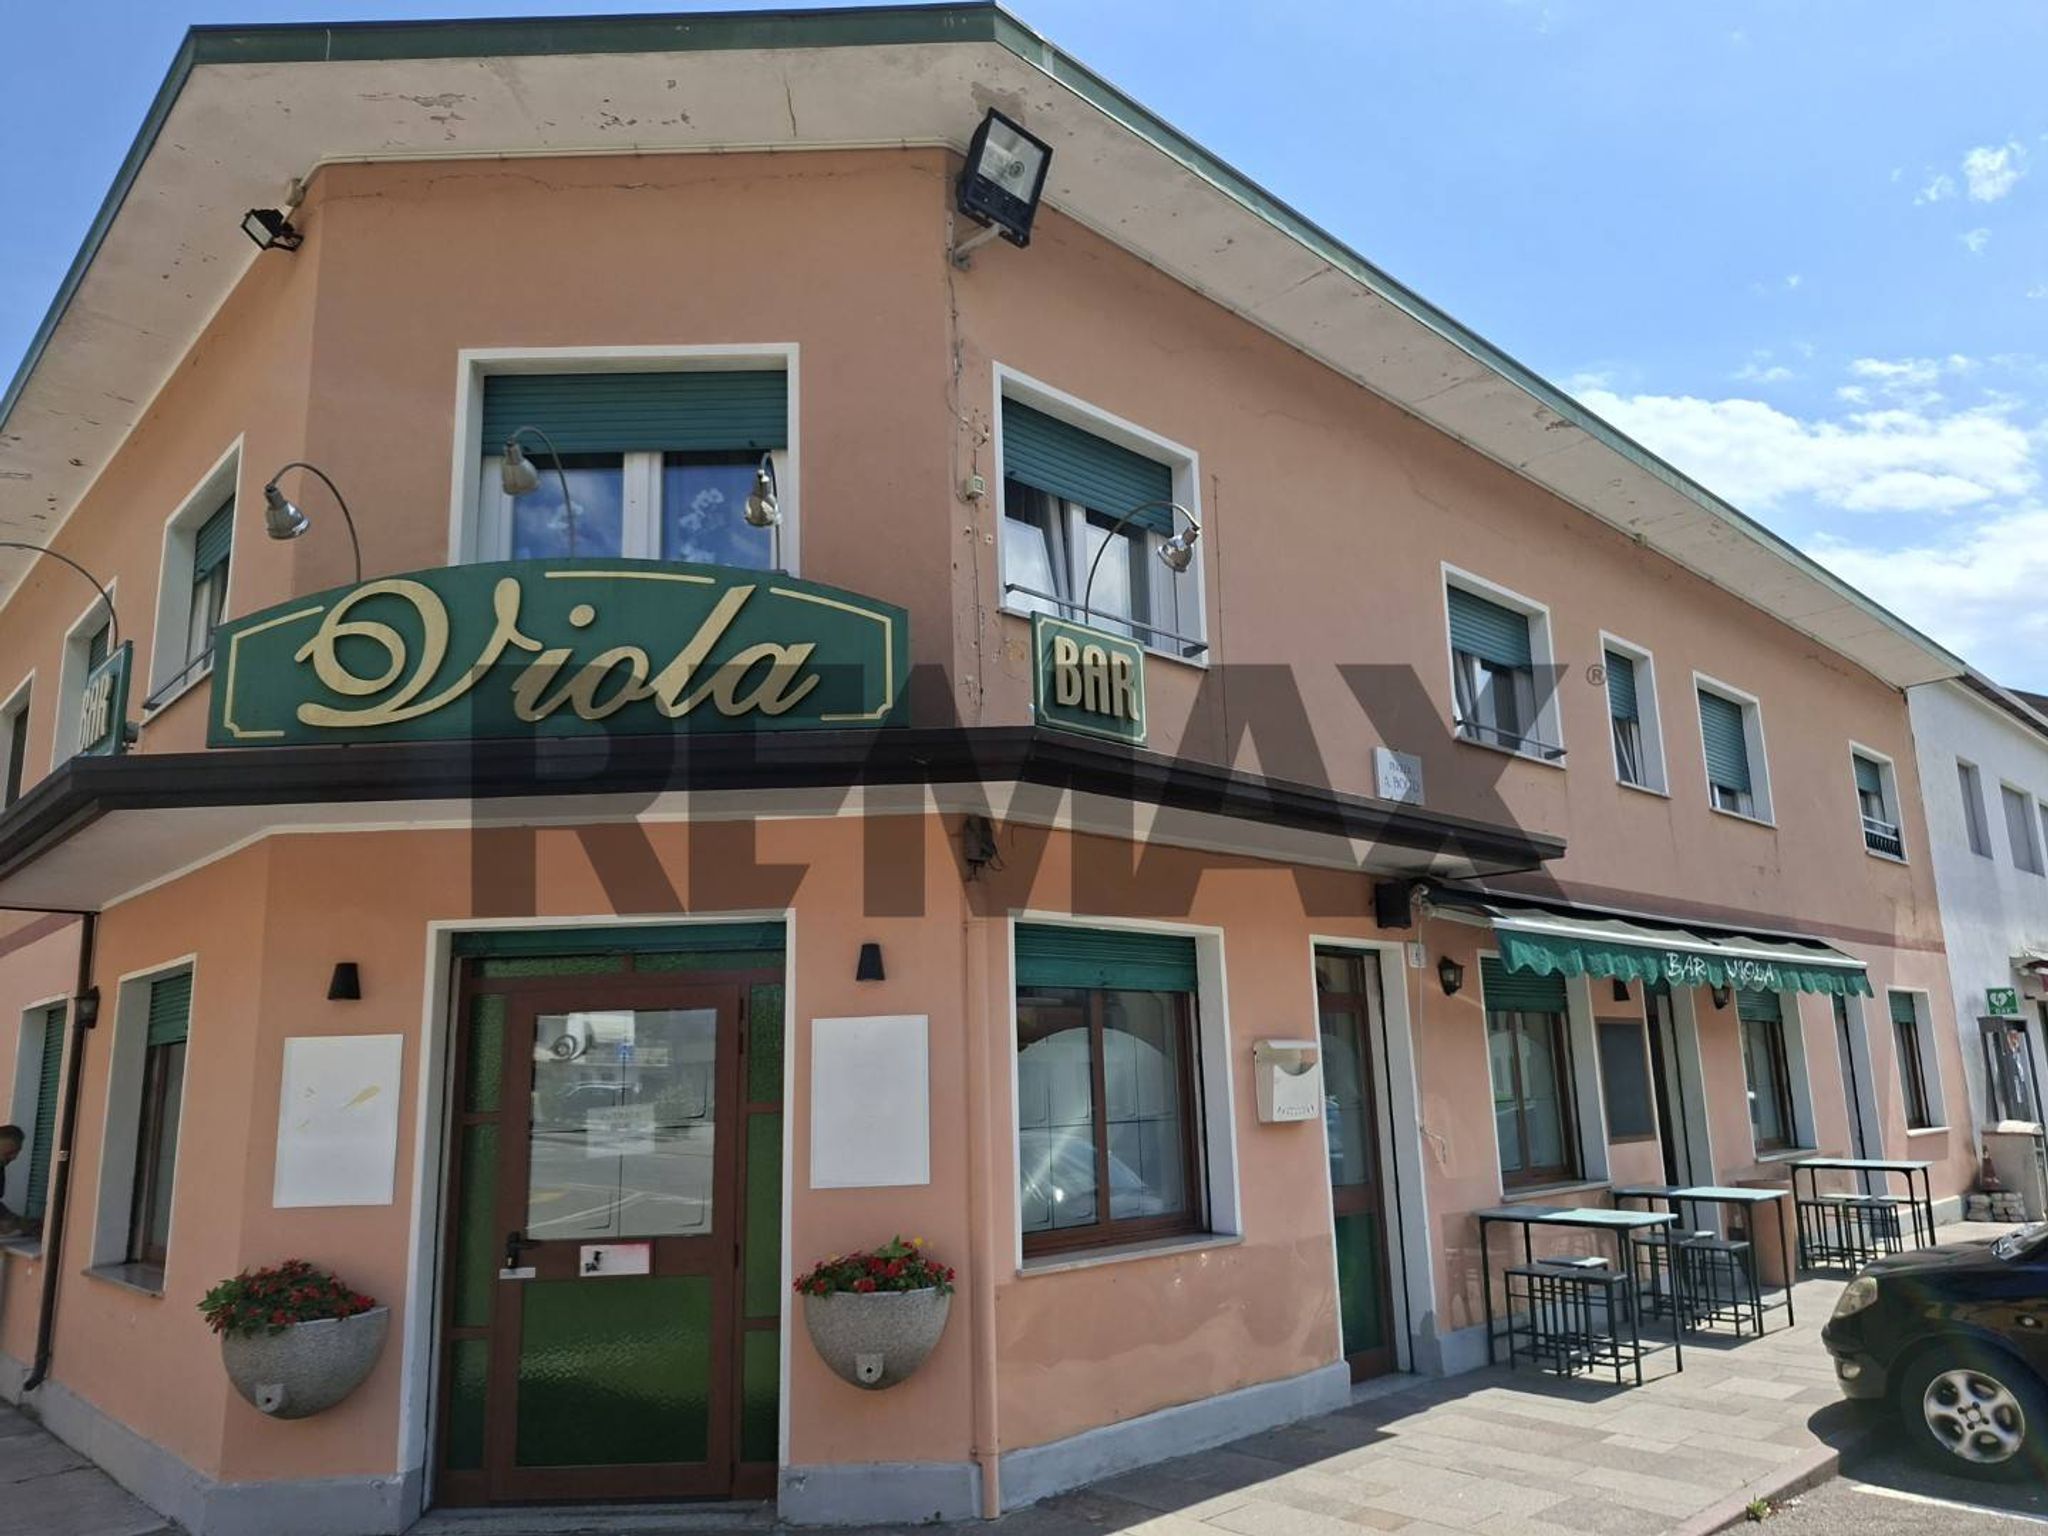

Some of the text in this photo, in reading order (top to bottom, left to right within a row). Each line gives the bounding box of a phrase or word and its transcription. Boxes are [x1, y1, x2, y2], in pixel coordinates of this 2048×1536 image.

[294, 577, 821, 727] Viola
[1054, 635, 1140, 721] BAR
[79, 671, 113, 752] BAR
[1666, 951, 1775, 983] BAR VIOLA
